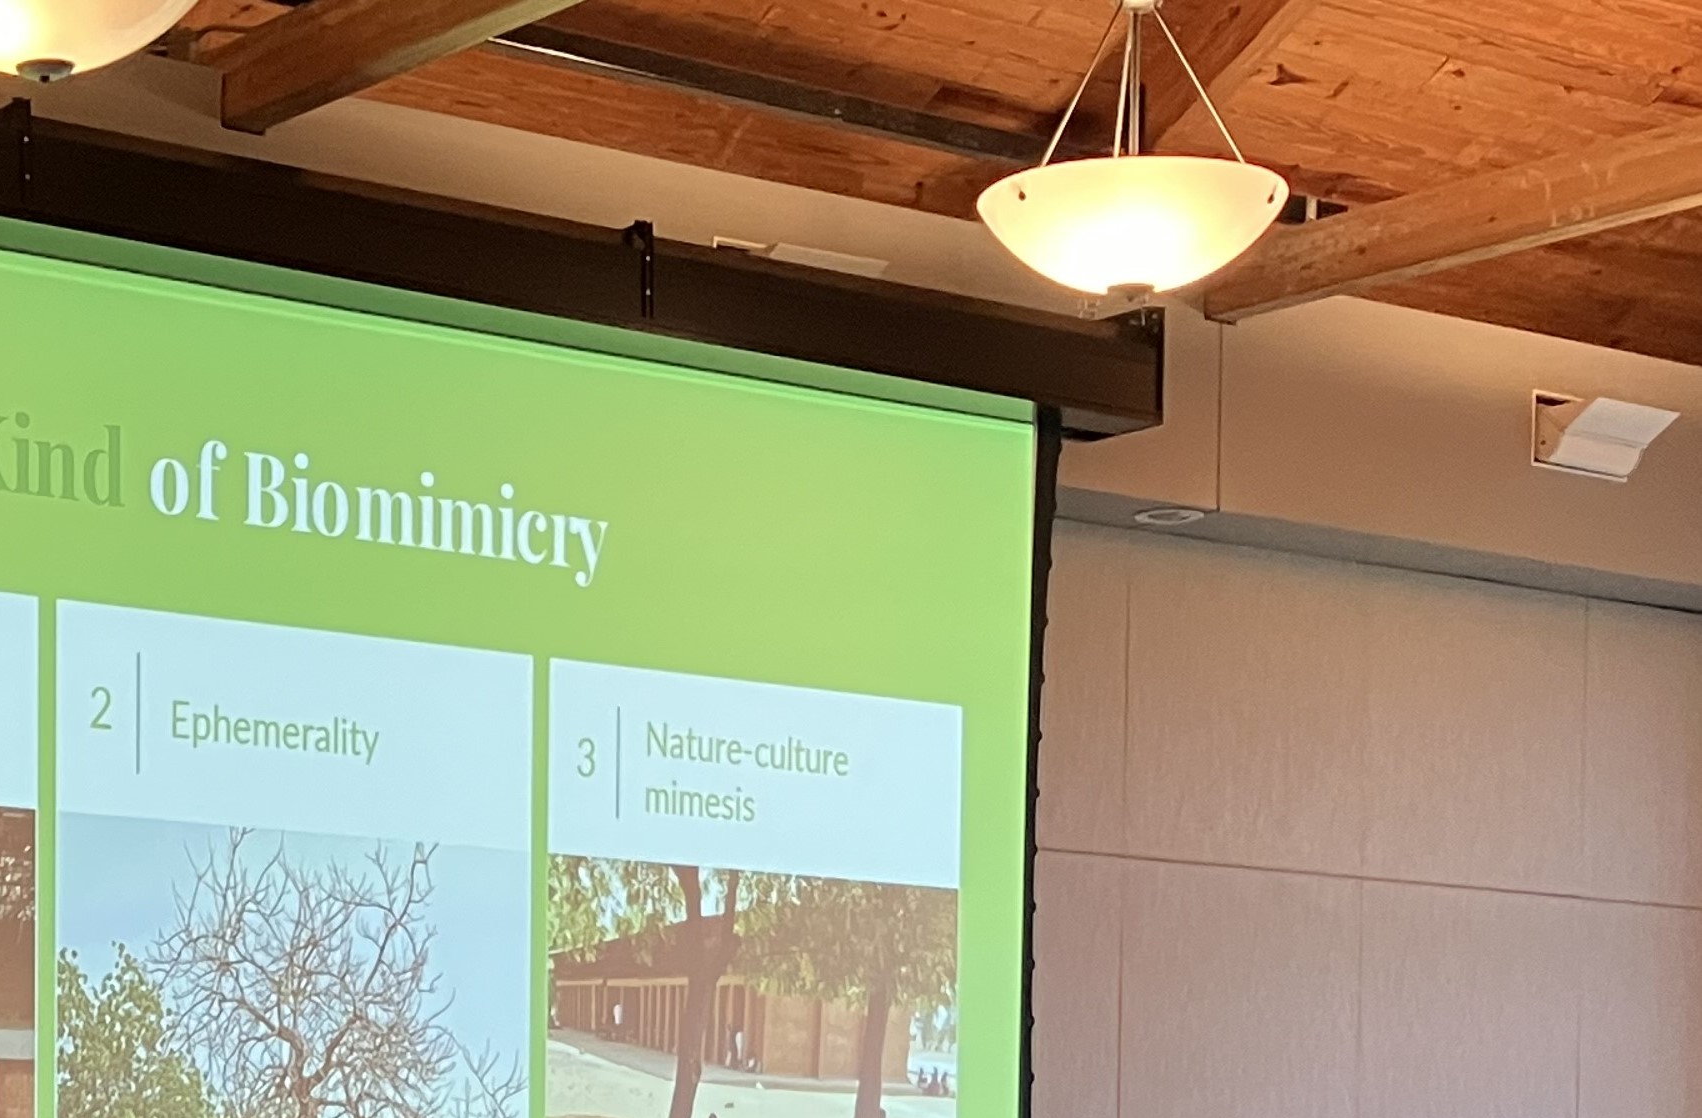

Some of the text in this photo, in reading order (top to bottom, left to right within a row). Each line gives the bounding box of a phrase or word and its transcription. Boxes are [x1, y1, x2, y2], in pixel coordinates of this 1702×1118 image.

[149, 440, 228, 520] of
[243, 452, 609, 587] Biomimicry
[89, 686, 113, 731] 2
[171, 700, 380, 766] Ephemerality
[576, 737, 597, 779] 3
[646, 721, 850, 778] Nature-culture
[645, 779, 756, 825] mimesis
